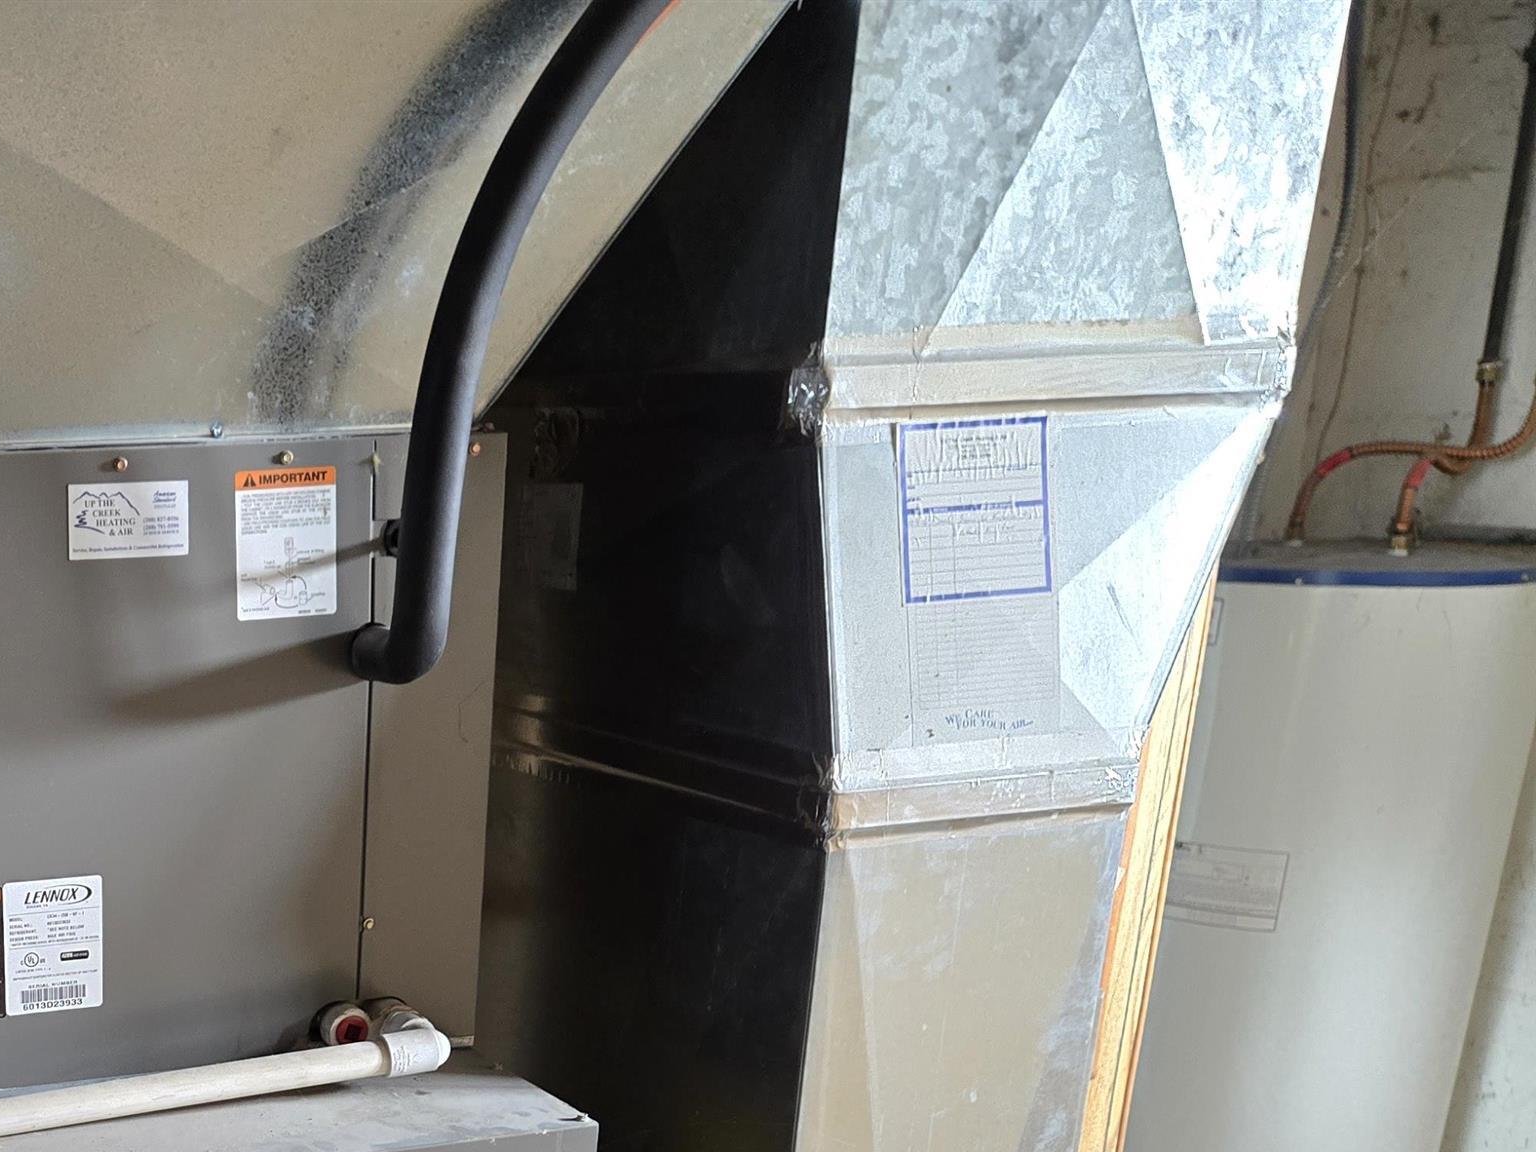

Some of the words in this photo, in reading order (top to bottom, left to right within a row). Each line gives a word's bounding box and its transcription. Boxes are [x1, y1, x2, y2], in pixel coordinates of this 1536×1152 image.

[259, 471, 327, 484] IMPORTANT
[84, 500, 95, 508] UP
[98, 499, 115, 507] THE
[92, 509, 121, 517] CREEK
[96, 518, 136, 527] HEATING
[117, 528, 134, 536] AIR
[24, 888, 79, 904] LENNOX
